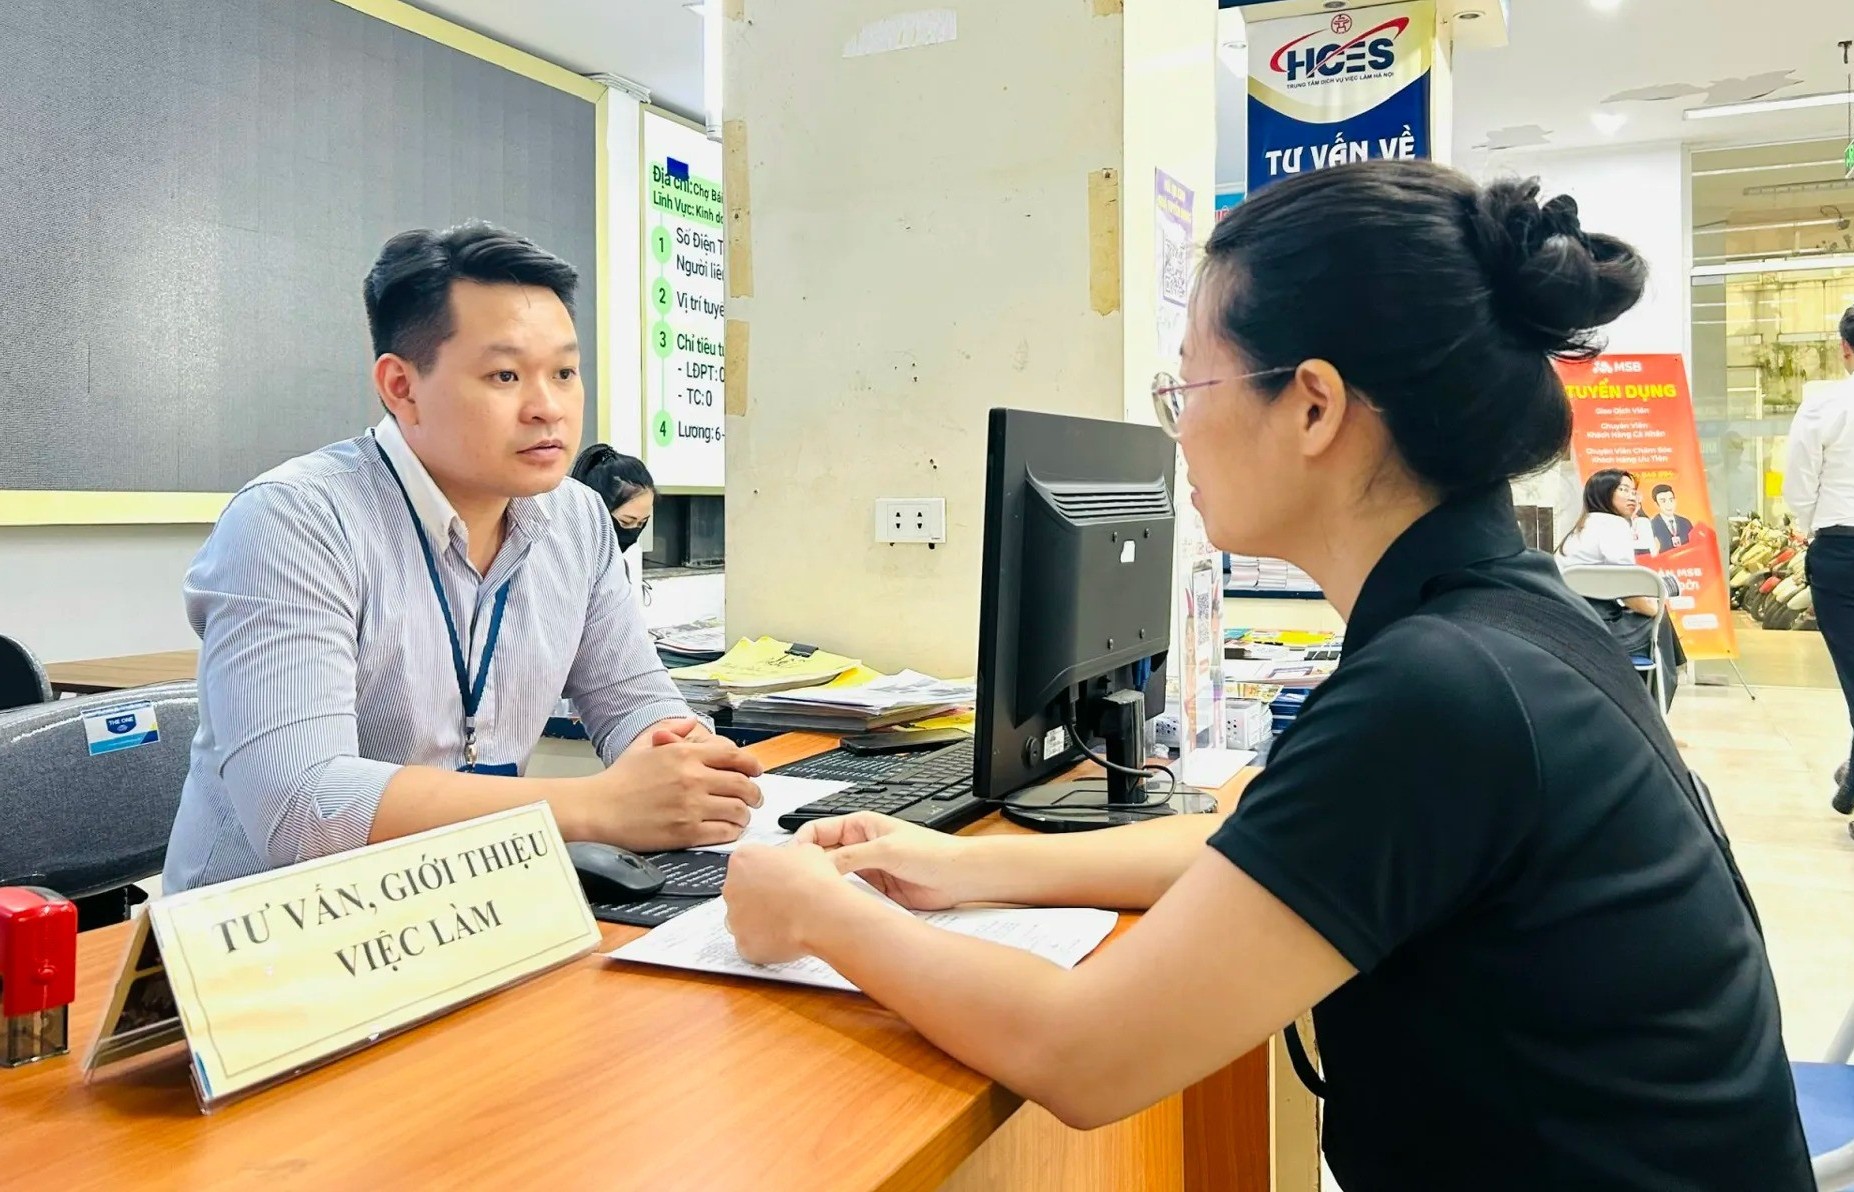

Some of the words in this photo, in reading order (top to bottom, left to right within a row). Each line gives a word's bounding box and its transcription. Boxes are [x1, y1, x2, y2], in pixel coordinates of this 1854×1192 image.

[1287, 38, 1395, 81] HCES
[1265, 146, 1303, 176] TƯ
[1310, 132, 1369, 170] VẤN
[1379, 125, 1416, 160] VỀ
[696, 205, 714, 221] Kinh
[658, 237, 664, 253] 1
[676, 227, 690, 246] Số
[693, 232, 716, 256] Điện
[676, 254, 708, 277] Người
[658, 287, 666, 304] 2
[677, 291, 688, 314] Vị
[690, 295, 702, 311] trí
[659, 331, 667, 347] 3
[677, 333, 695, 352] Chỉ
[697, 337, 716, 355] tiêu
[1614, 361, 1642, 372] MSB
[1565, 377, 1622, 399] TUYỂN
[1625, 383, 1677, 402] DỤNG
[659, 420, 667, 437] 4
[1677, 567, 1703, 577] MSB
[215, 903, 272, 954] TƯ
[281, 882, 378, 931] VẤN,
[380, 854, 458, 903] GIỚI
[458, 829, 549, 877] THIỆU
[333, 926, 425, 978] VIỆC
[427, 899, 504, 947] LÀM
